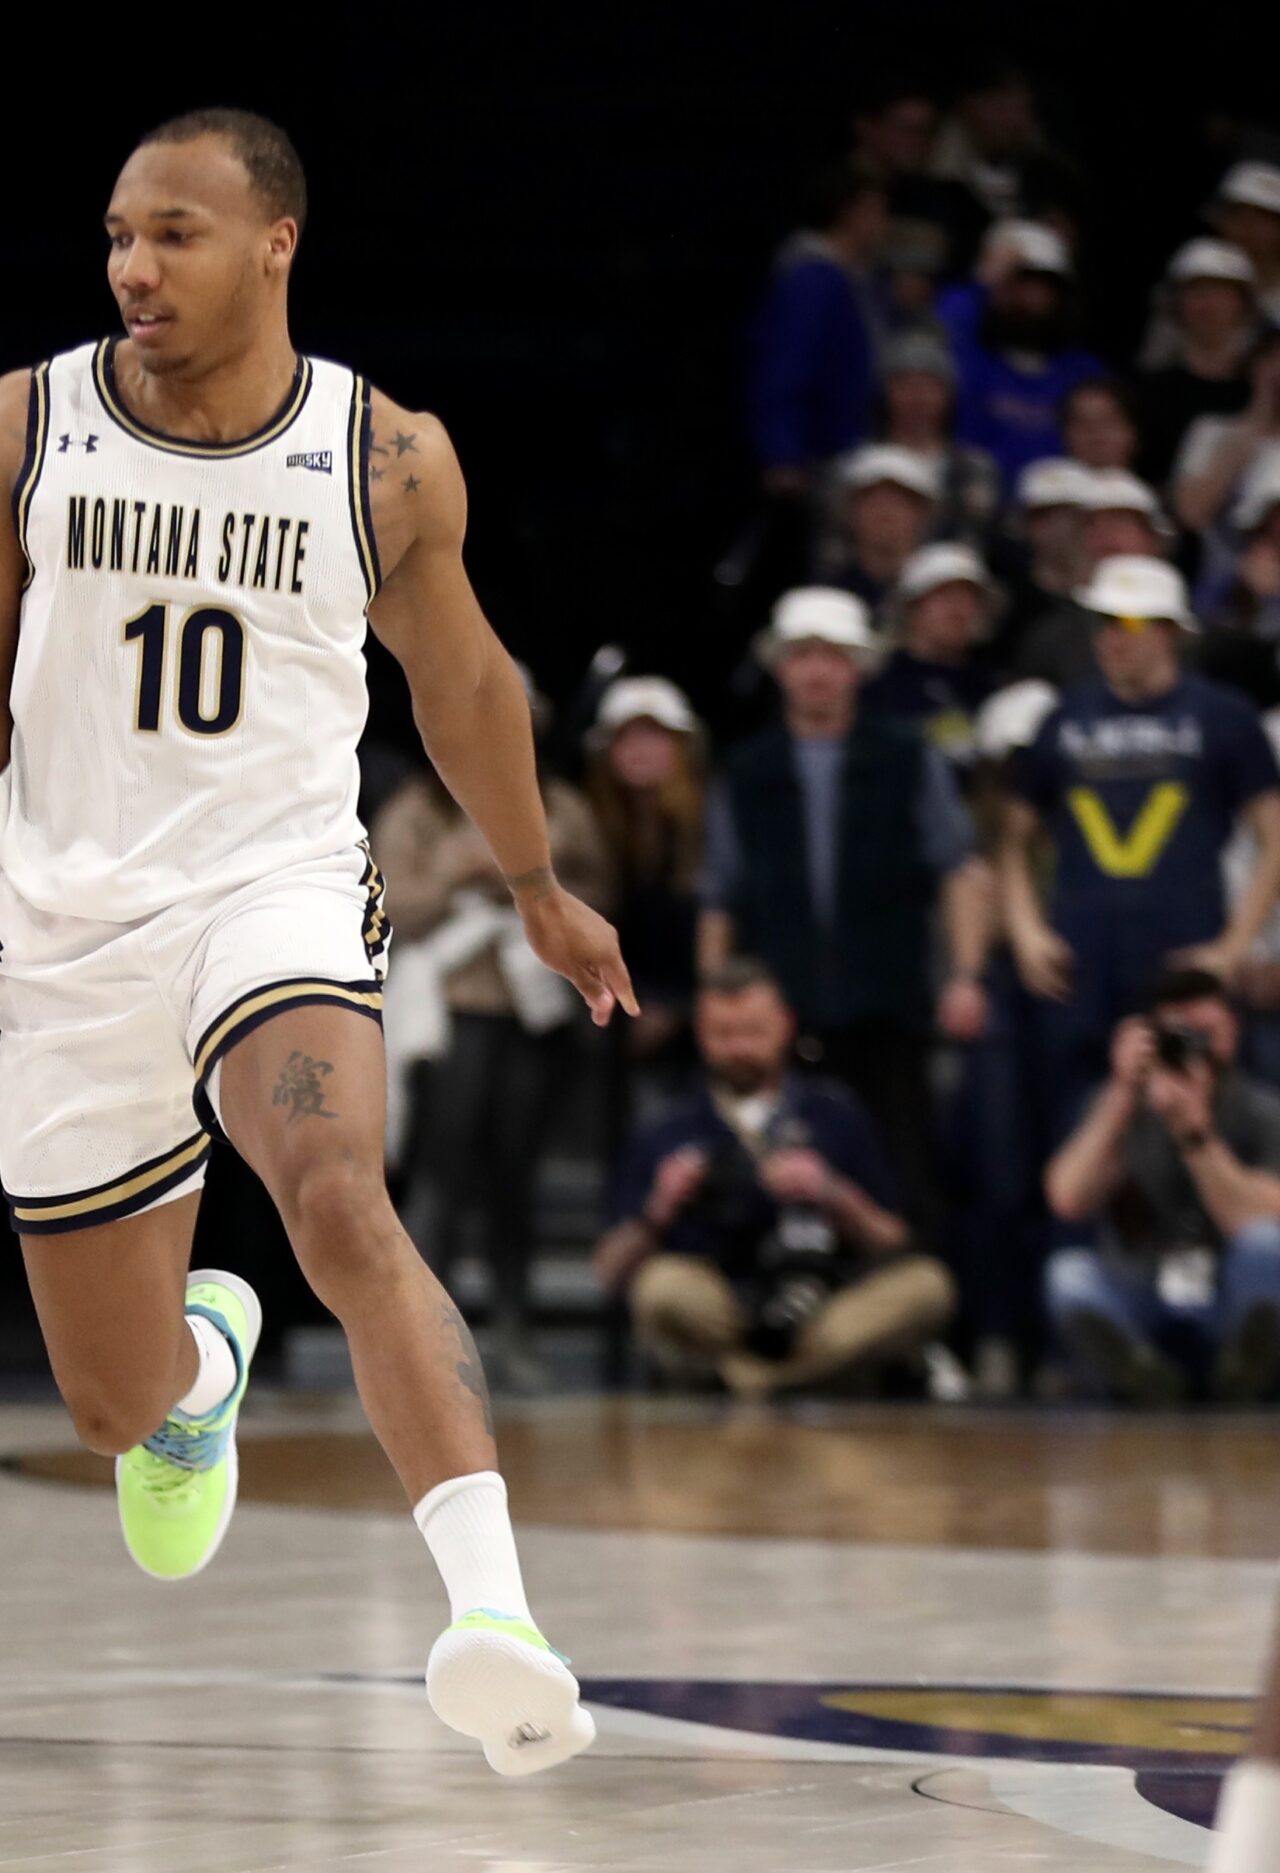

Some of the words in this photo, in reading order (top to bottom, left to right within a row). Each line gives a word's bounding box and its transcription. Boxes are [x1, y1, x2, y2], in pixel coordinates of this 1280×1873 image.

[65, 495, 201, 580] MONTANA
[218, 510, 311, 595] STATE
[120, 600, 249, 740] 10
